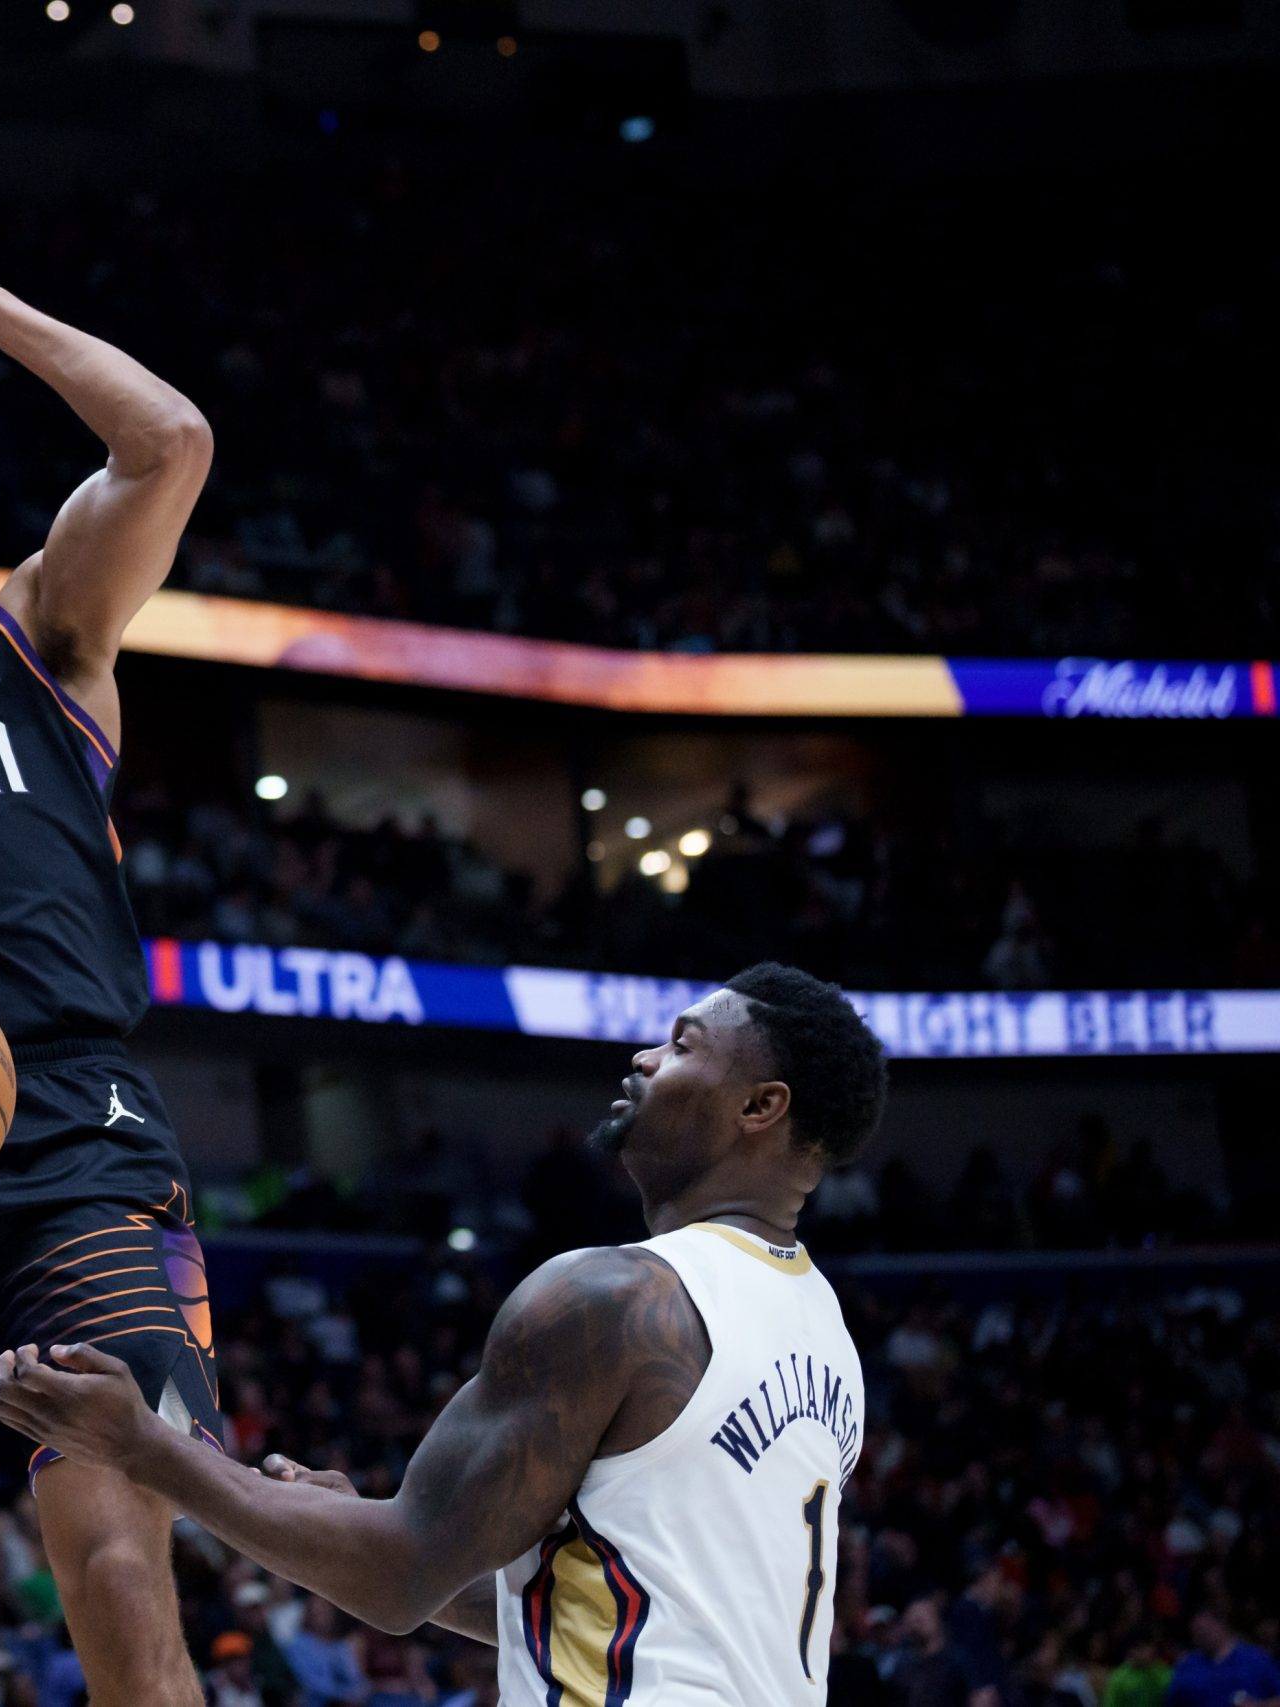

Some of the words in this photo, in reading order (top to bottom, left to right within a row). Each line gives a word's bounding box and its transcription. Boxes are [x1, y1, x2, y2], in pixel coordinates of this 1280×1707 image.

[197, 939, 425, 1026] ULTRA
[883, 991, 1038, 1057] IGHT
[798, 1478, 830, 1685] 1
